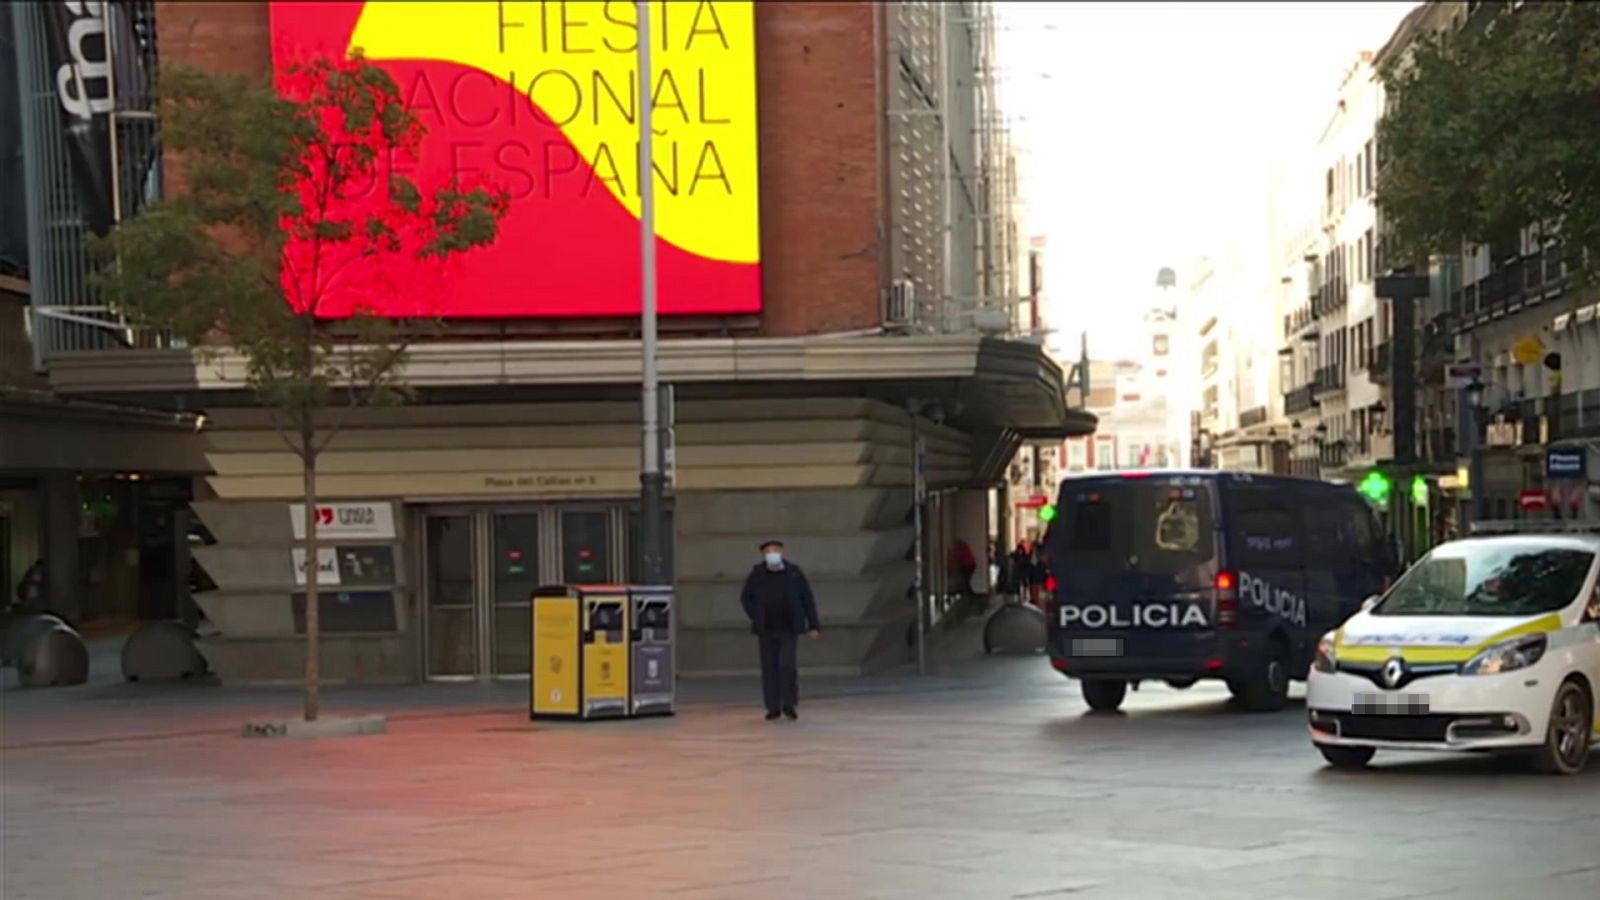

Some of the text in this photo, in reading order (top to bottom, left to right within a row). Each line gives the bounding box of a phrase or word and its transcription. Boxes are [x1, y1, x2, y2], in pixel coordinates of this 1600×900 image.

[398, 68, 731, 127] ACIONAL
[450, 129, 732, 199] ESPAÑA
[1060, 604, 1208, 628] POLICIA
[1239, 570, 1306, 629] POLICIA
